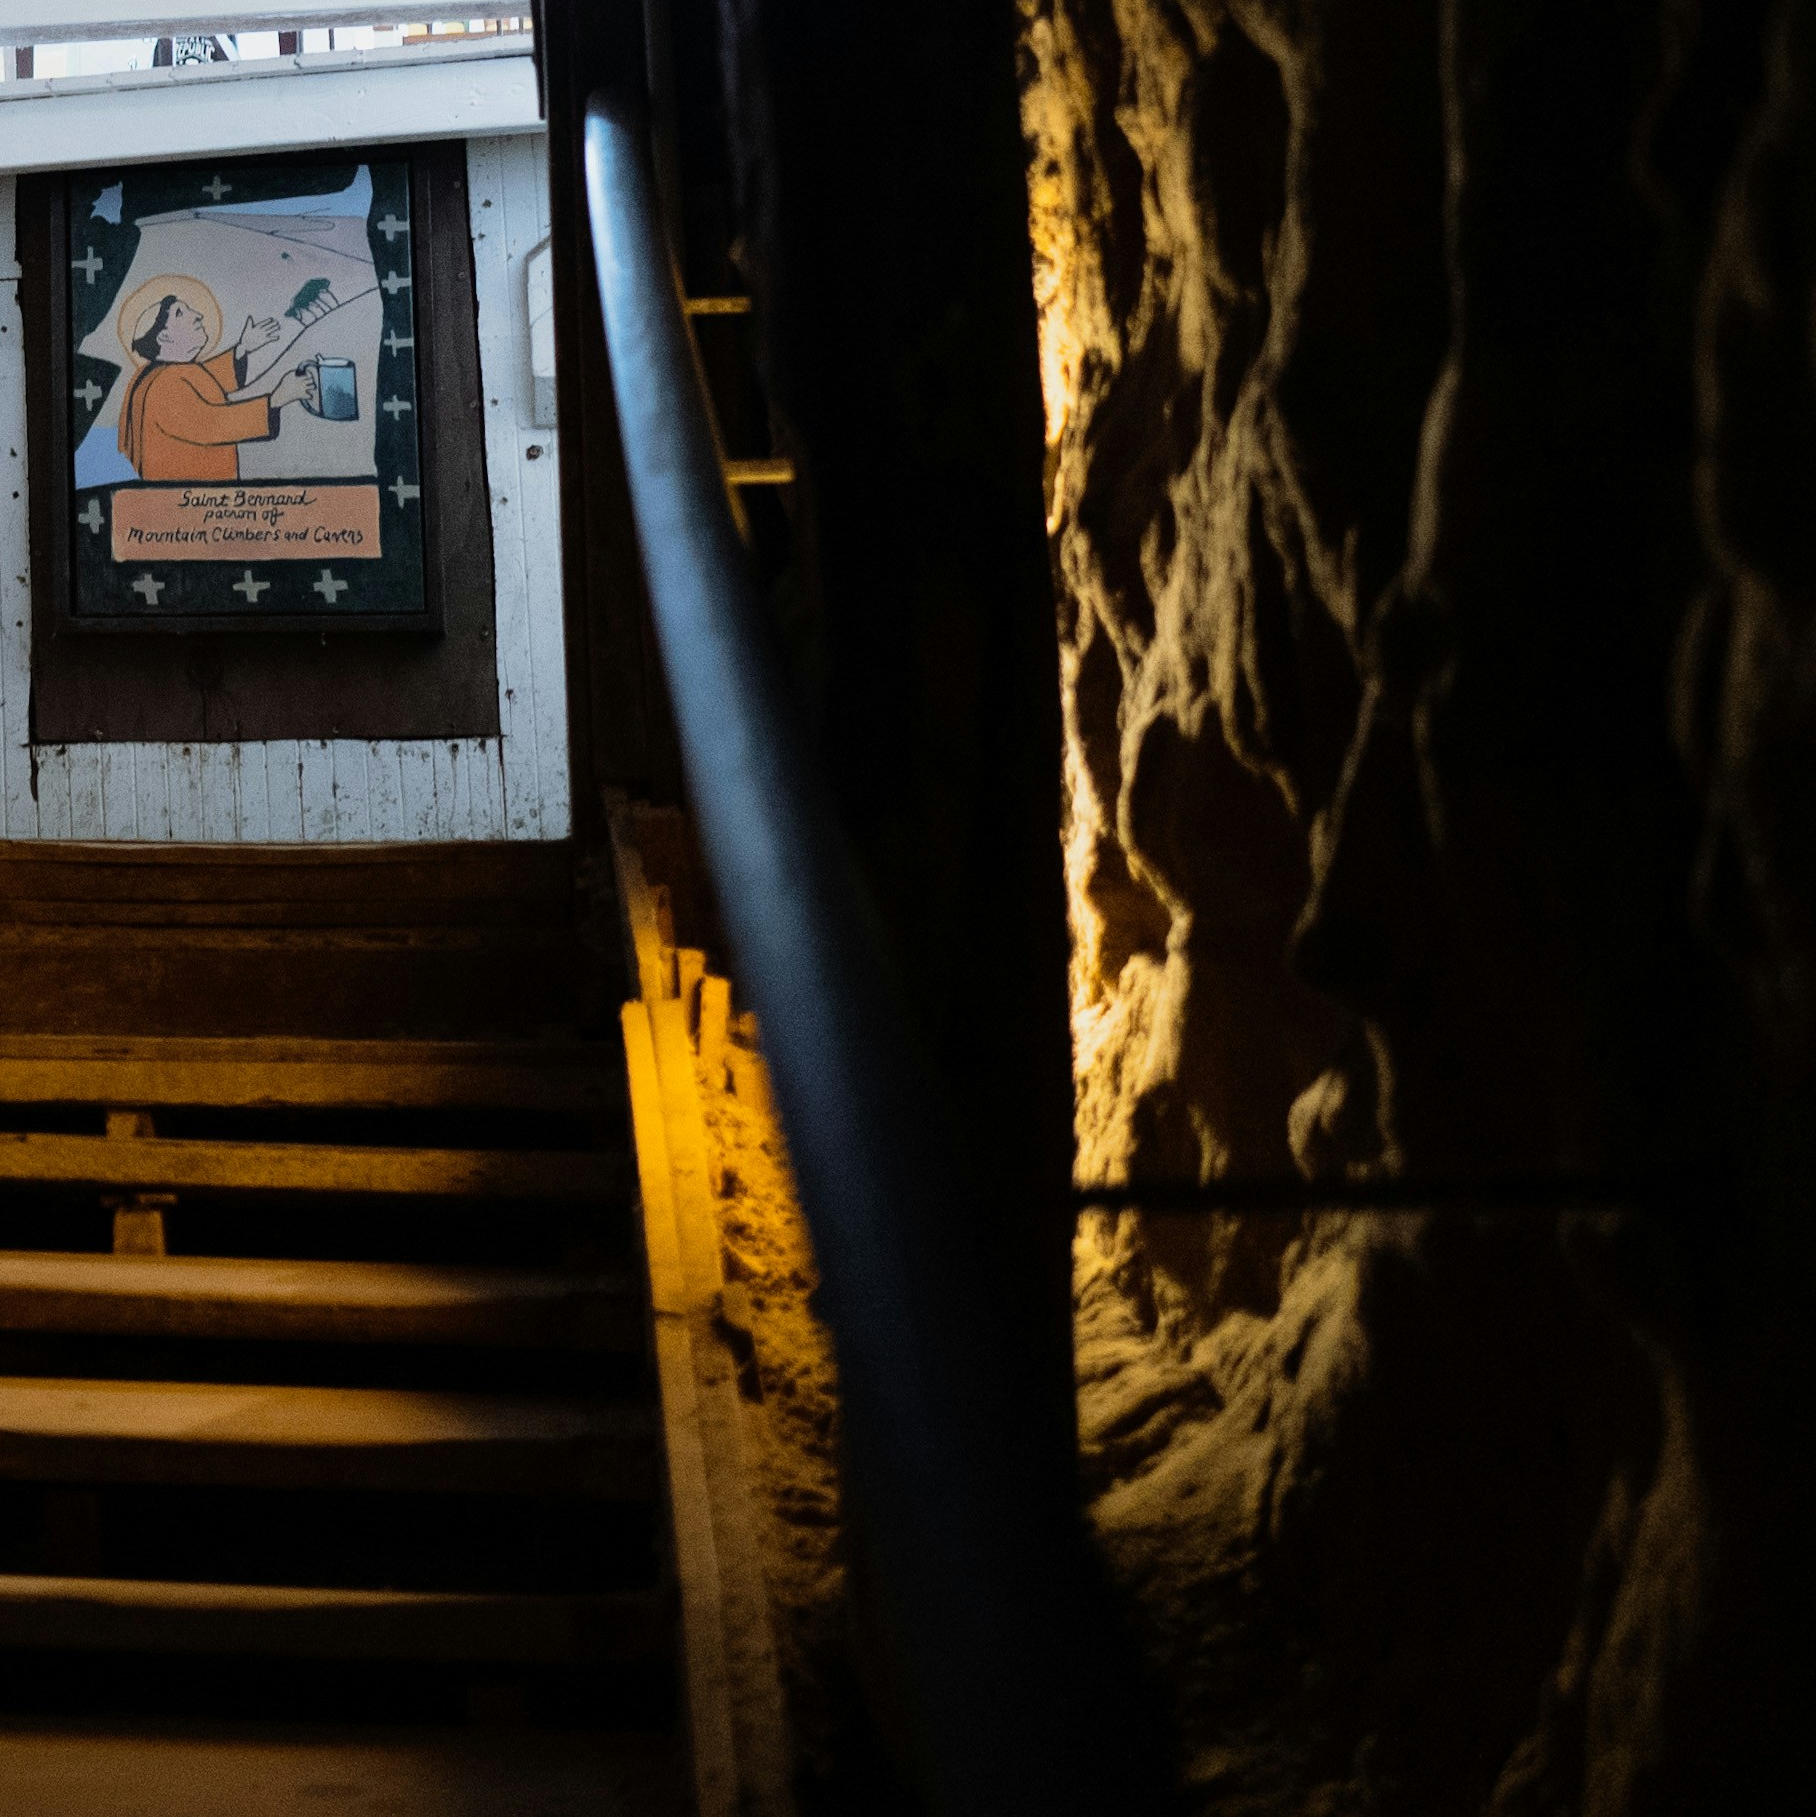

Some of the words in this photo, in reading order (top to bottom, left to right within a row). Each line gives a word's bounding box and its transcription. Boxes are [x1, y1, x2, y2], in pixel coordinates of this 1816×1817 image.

[178, 490, 228, 508] Saint
[203, 509, 257, 523] patron
[262, 509, 284, 526] of
[211, 527, 281, 543] Climbers
[284, 527, 307, 541] and
